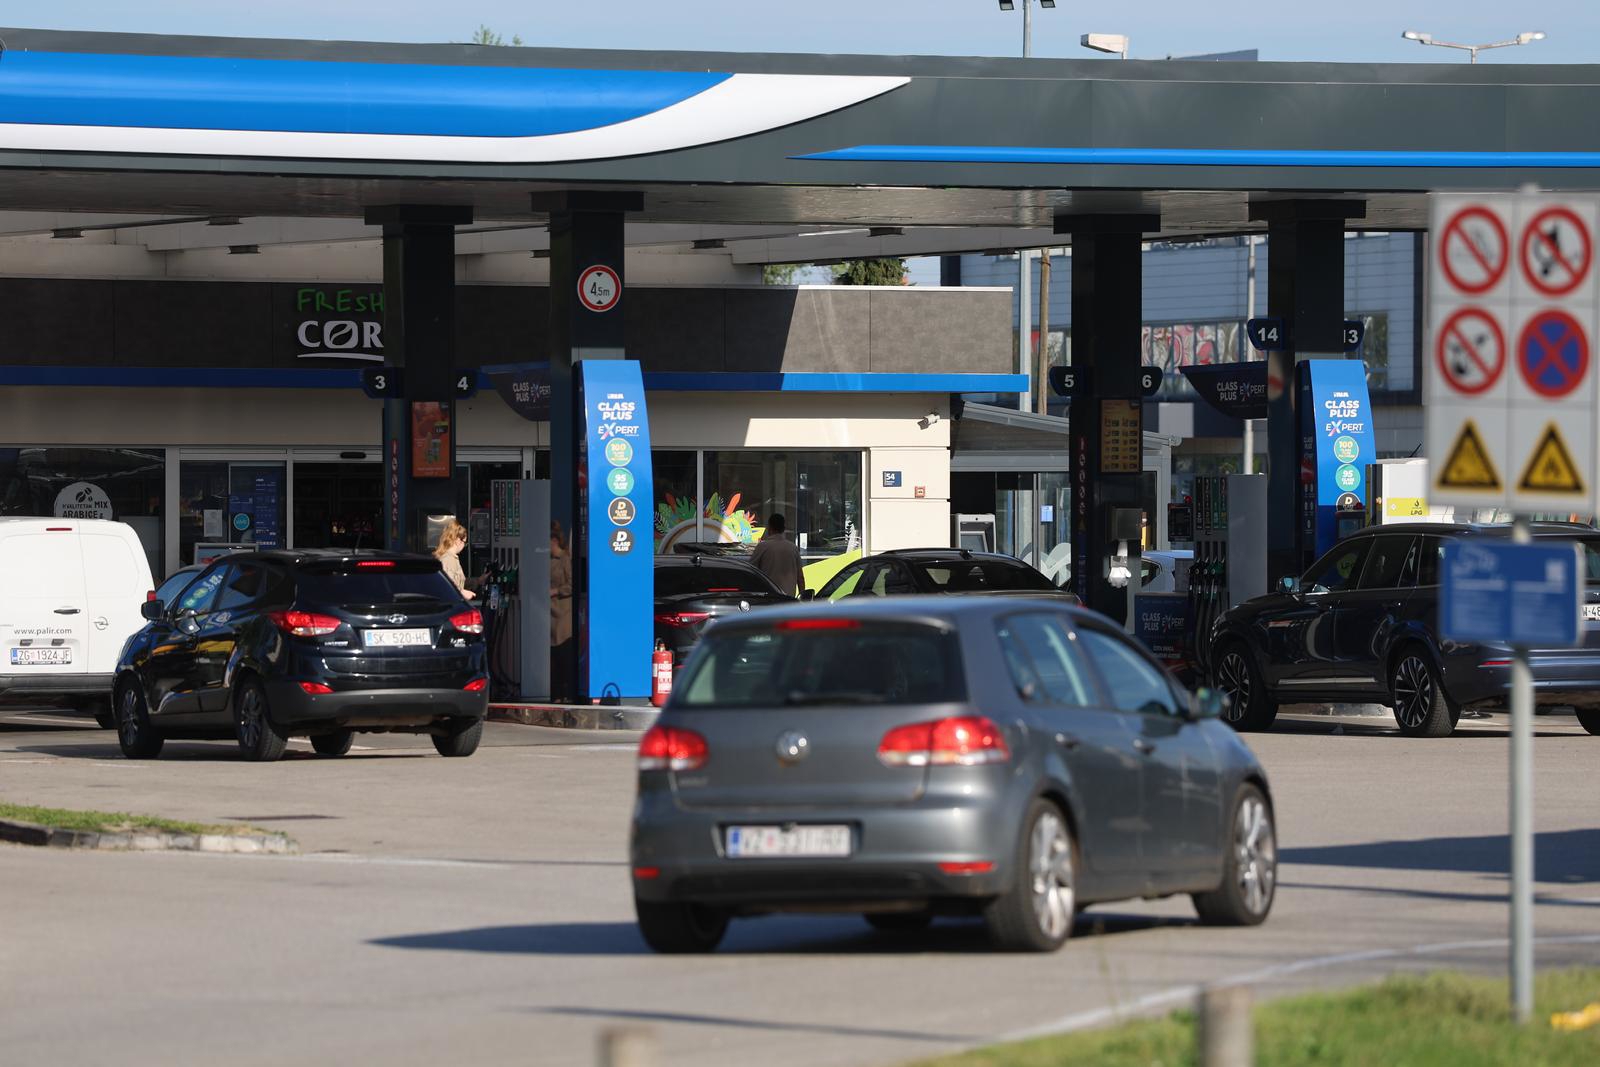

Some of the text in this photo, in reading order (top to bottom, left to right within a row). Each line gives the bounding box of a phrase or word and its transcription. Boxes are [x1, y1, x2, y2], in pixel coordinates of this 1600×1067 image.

[1257, 327, 1279, 342] 14
[375, 375, 386, 390] 3
[457, 376, 469, 390] 4
[1064, 374, 1075, 388] 5
[1141, 374, 1152, 388] 6
[512, 382, 530, 393] CLASS
[1216, 381, 1239, 392] CLASS
[515, 392, 530, 402] PLUS
[1219, 391, 1237, 401] PLUS
[597, 402, 636, 412] CLASS
[1325, 400, 1360, 409] CLASS
[602, 411, 633, 420] PLUS
[1329, 409, 1358, 418] PLUS
[597, 422, 639, 440] EXPERT
[1325, 420, 1364, 437] EXPERT
[1338, 441, 1354, 449] 100
[1342, 469, 1354, 478] 95
[94, 500, 108, 509] MIX
[617, 501, 626, 510] D
[1344, 496, 1353, 505] D
[62, 510, 98, 519] ARABICE
[616, 531, 628, 541] D
[1142, 612, 1161, 622] CLASS
[13, 627, 73, 636] www.palir.com
[1143, 622, 1159, 631] PLUS
[373, 634, 384, 644] SK
[18, 650, 30, 661] ZG
